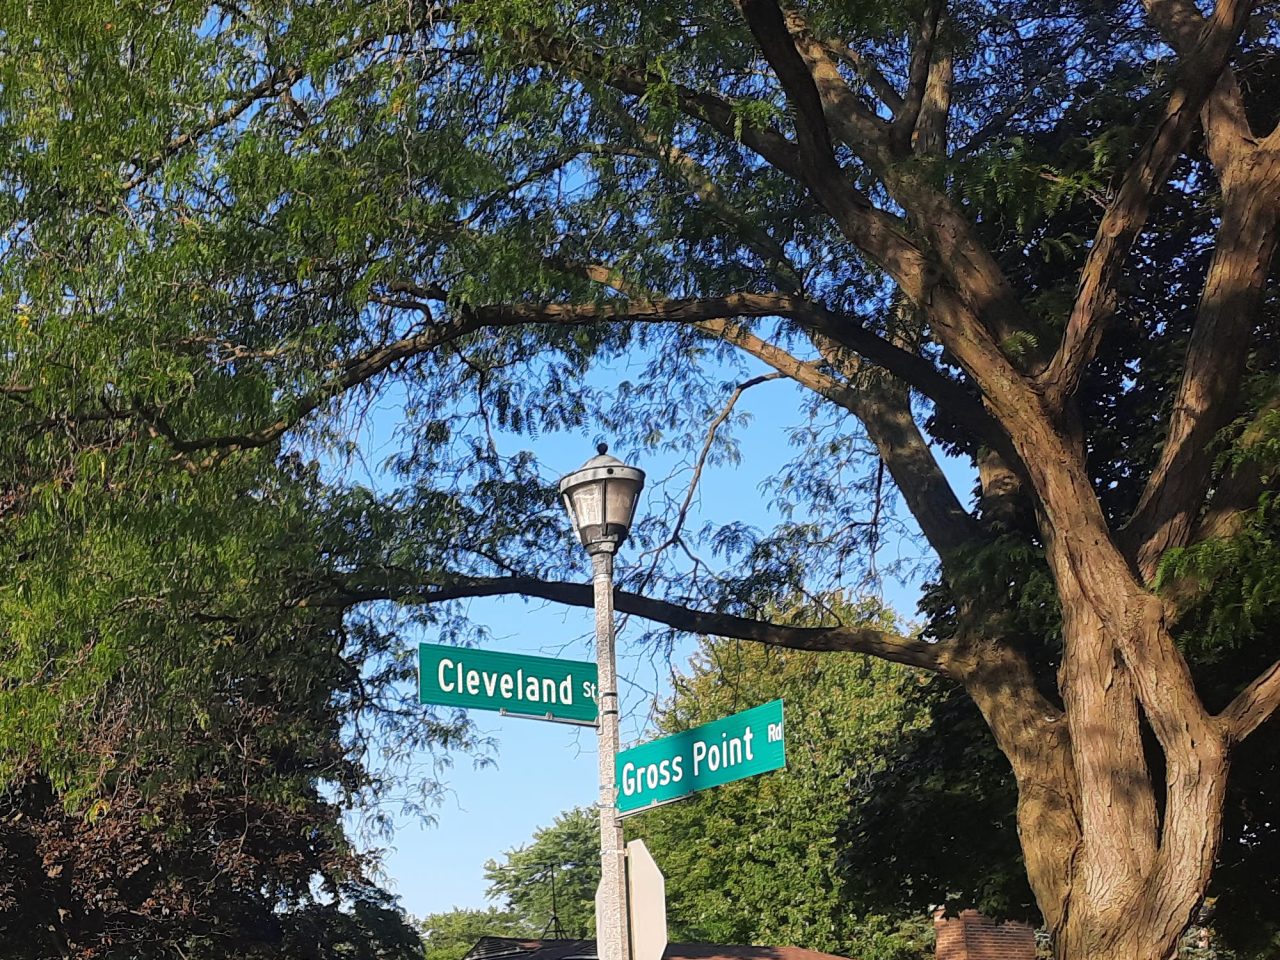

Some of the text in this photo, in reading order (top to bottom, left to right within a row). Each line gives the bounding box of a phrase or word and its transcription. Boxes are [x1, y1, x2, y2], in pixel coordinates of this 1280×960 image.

[437, 658, 596, 705] Cleveland St
[622, 722, 783, 797] Gross Point Rd
